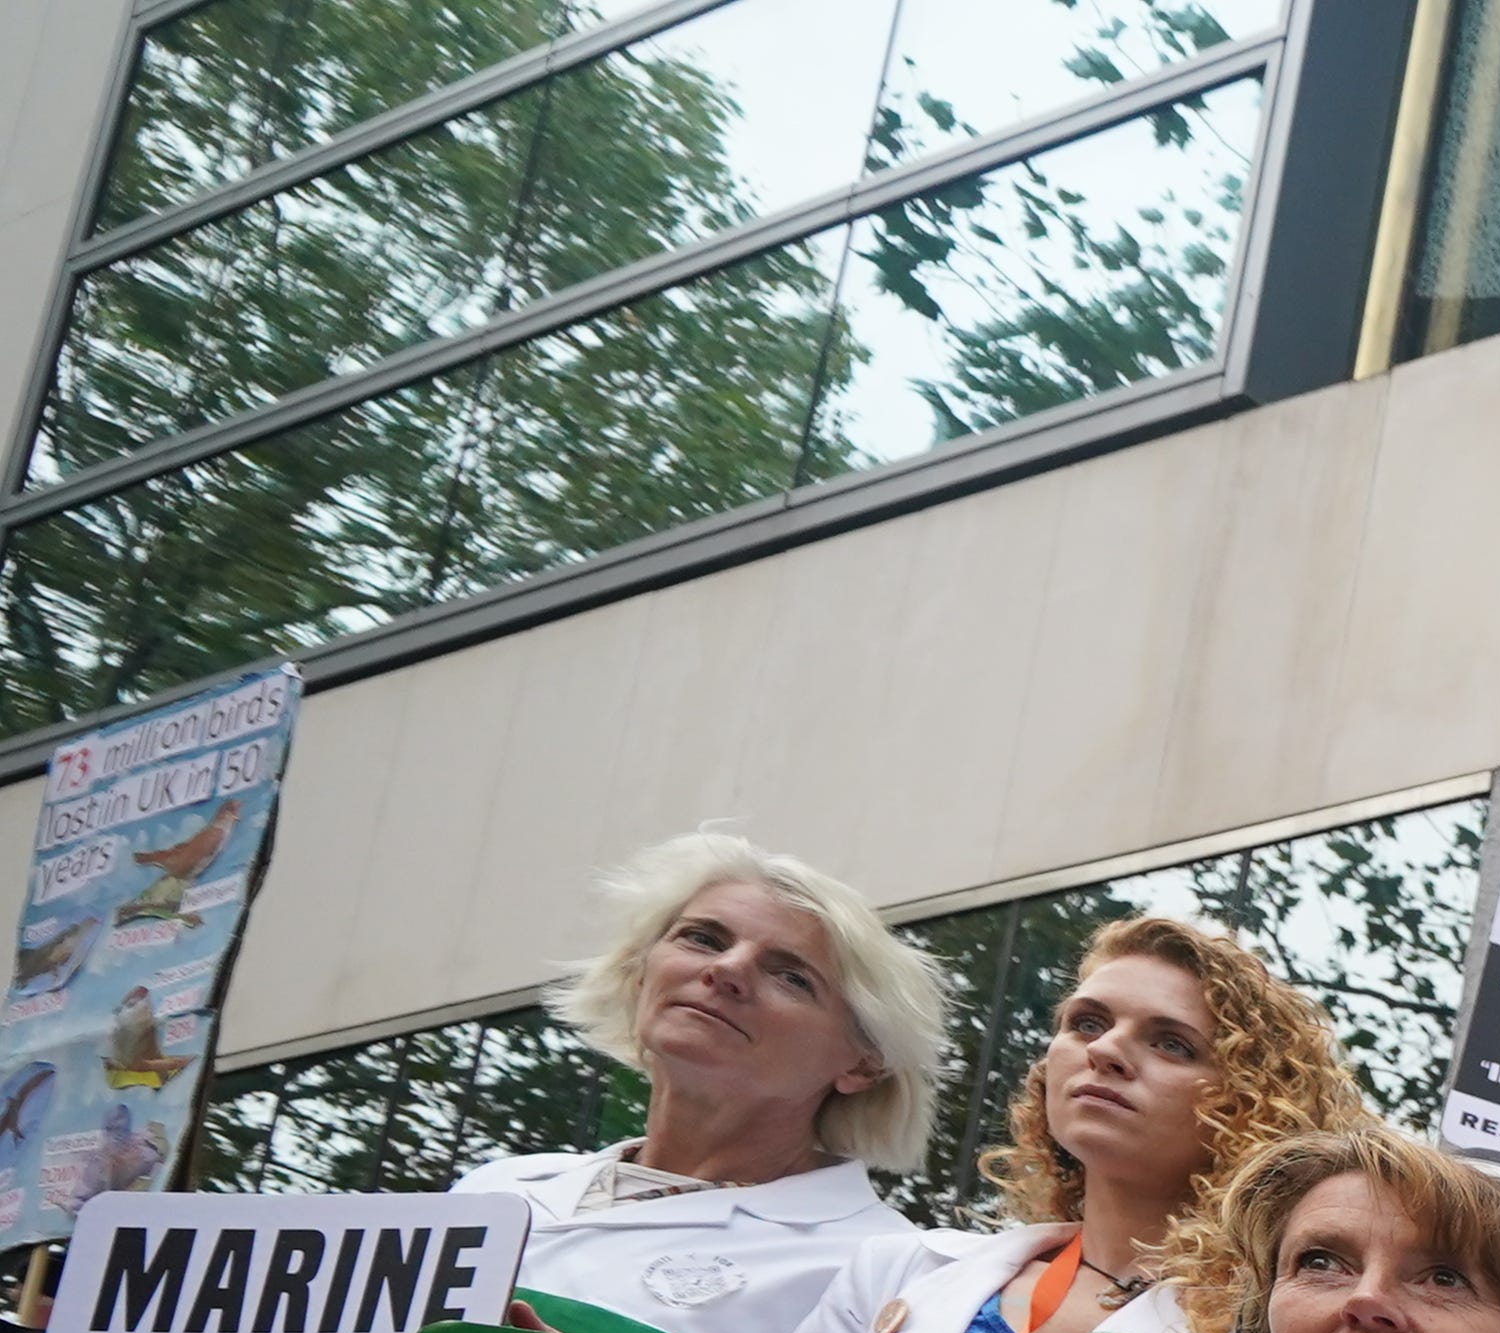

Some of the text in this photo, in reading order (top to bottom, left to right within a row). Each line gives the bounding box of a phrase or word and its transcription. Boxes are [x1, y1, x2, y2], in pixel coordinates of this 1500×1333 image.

[102, 704, 202, 775] million
[206, 683, 282, 738] birds
[223, 743, 262, 793] 50
[38, 841, 114, 901] years
[90, 1227, 488, 1333] MARINE
